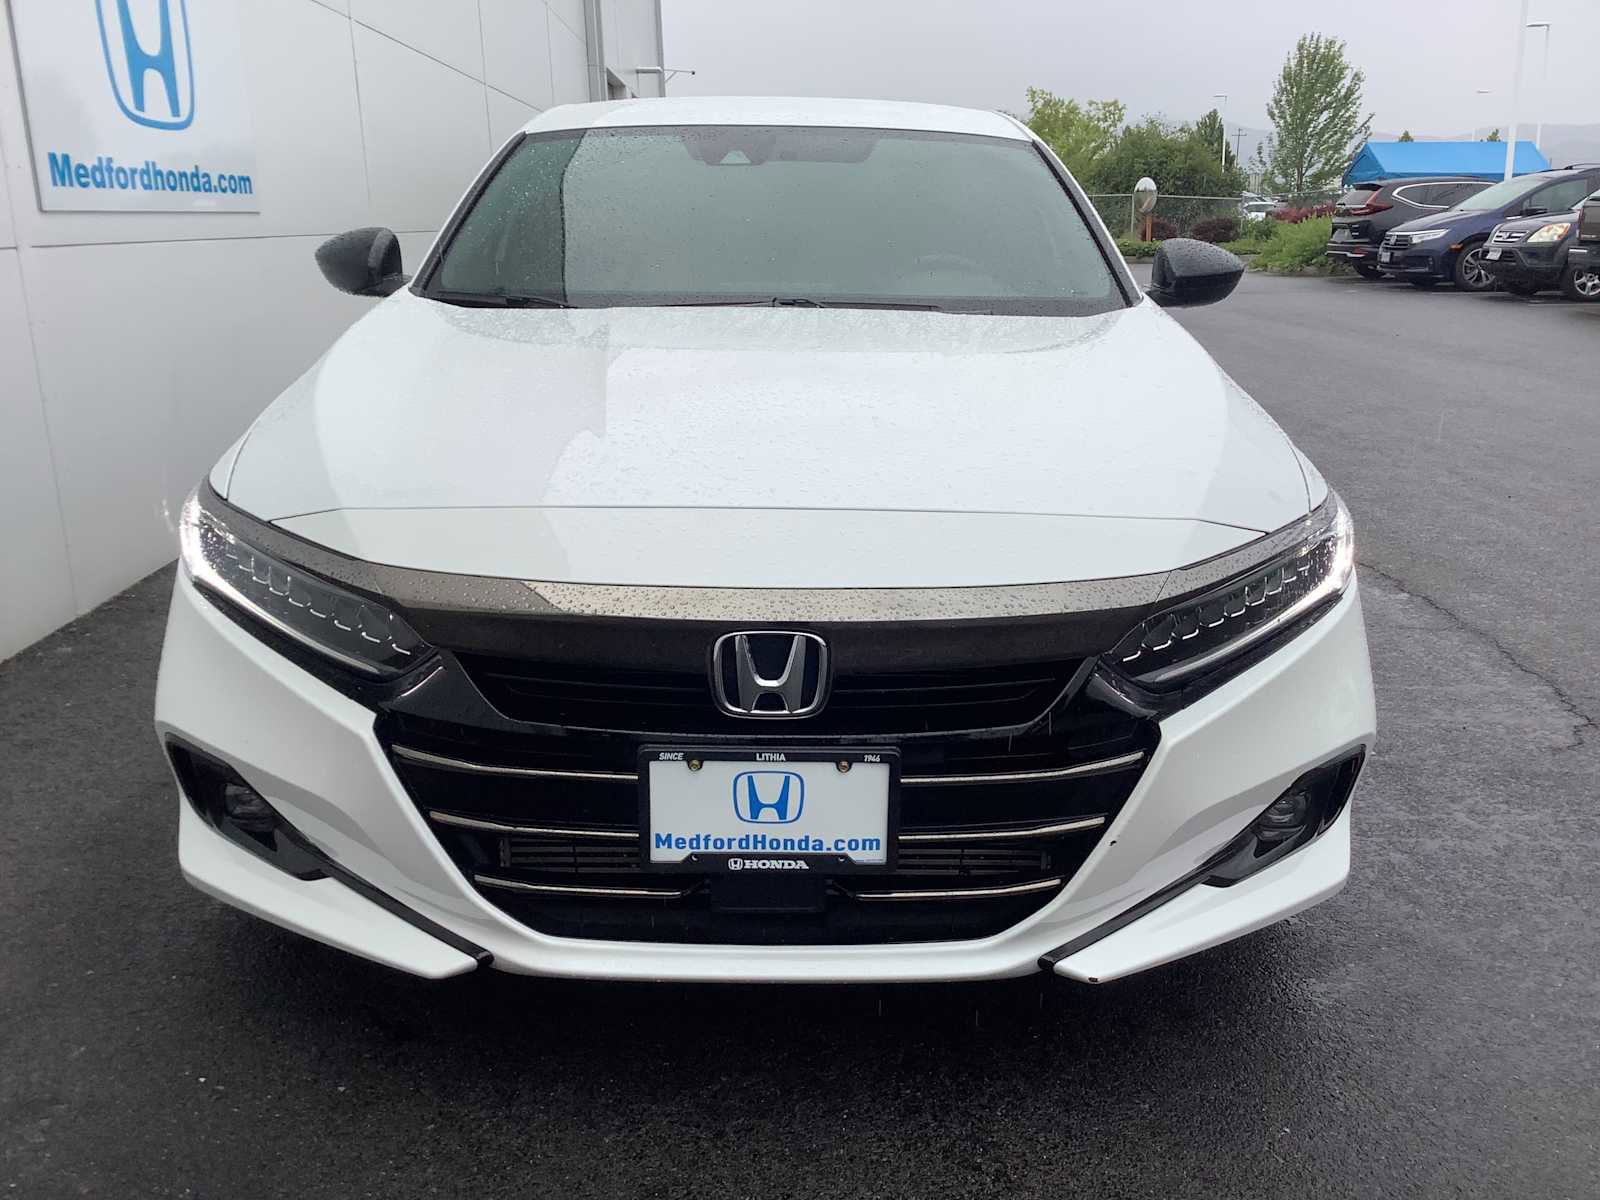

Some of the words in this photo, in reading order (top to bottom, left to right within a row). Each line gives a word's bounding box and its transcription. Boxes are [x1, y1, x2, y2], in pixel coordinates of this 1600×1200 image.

[47, 152, 253, 194] Medfordhonda.com
[659, 752, 684, 760] SINCE
[756, 753, 786, 761] LITHIA
[654, 832, 881, 851] MedfordHonda.com
[744, 860, 809, 870] HONDA
